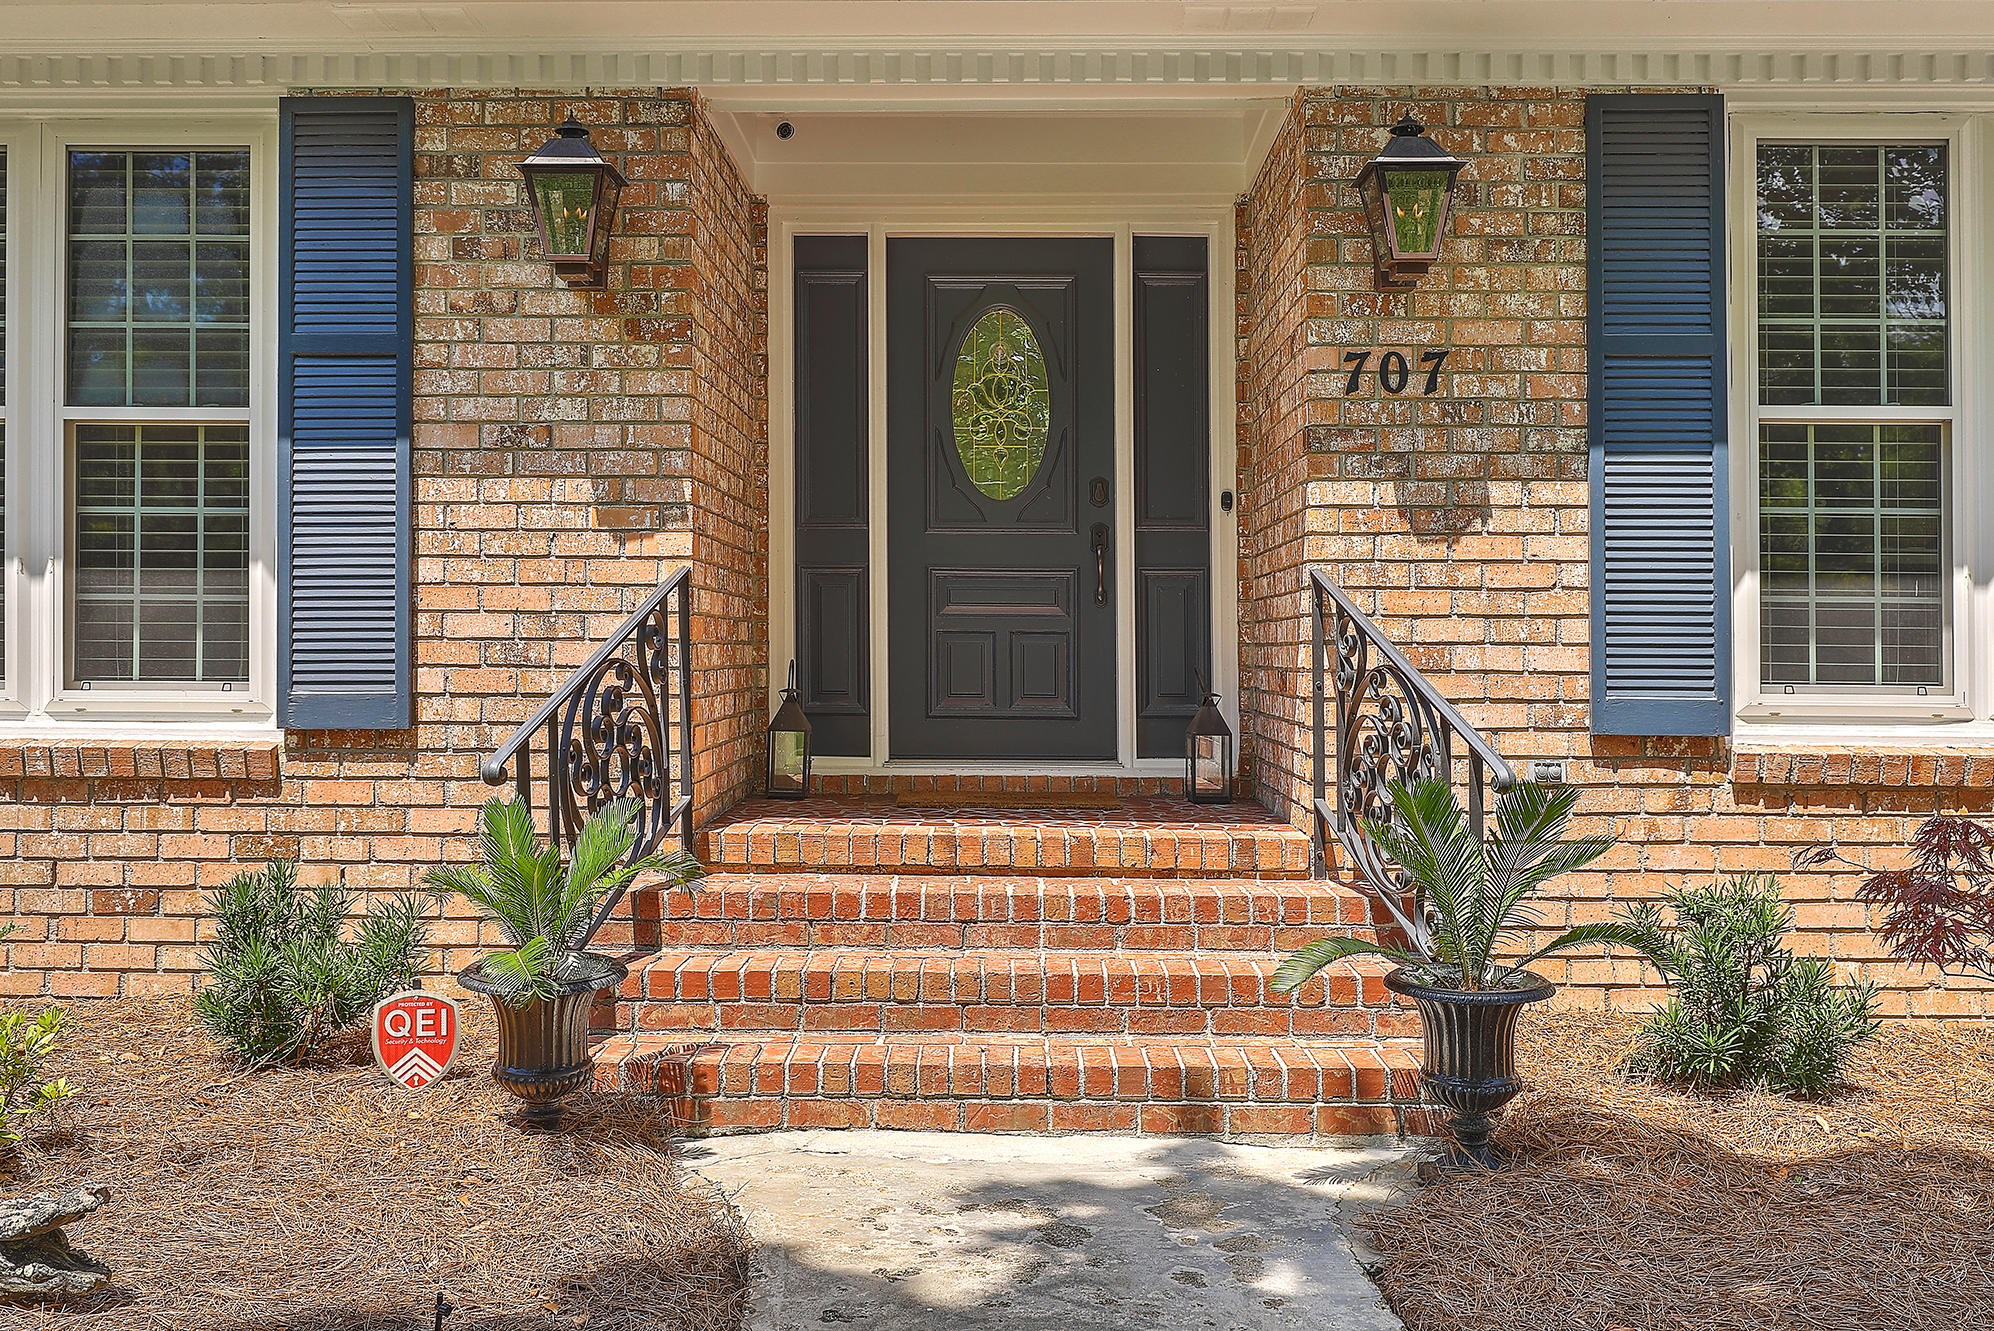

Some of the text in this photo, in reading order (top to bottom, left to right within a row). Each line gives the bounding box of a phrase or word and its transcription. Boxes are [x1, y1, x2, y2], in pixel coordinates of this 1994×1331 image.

[1343, 351, 1449, 395] 707
[384, 1008, 448, 1037] QEI
[415, 1037, 447, 1045] Technology
